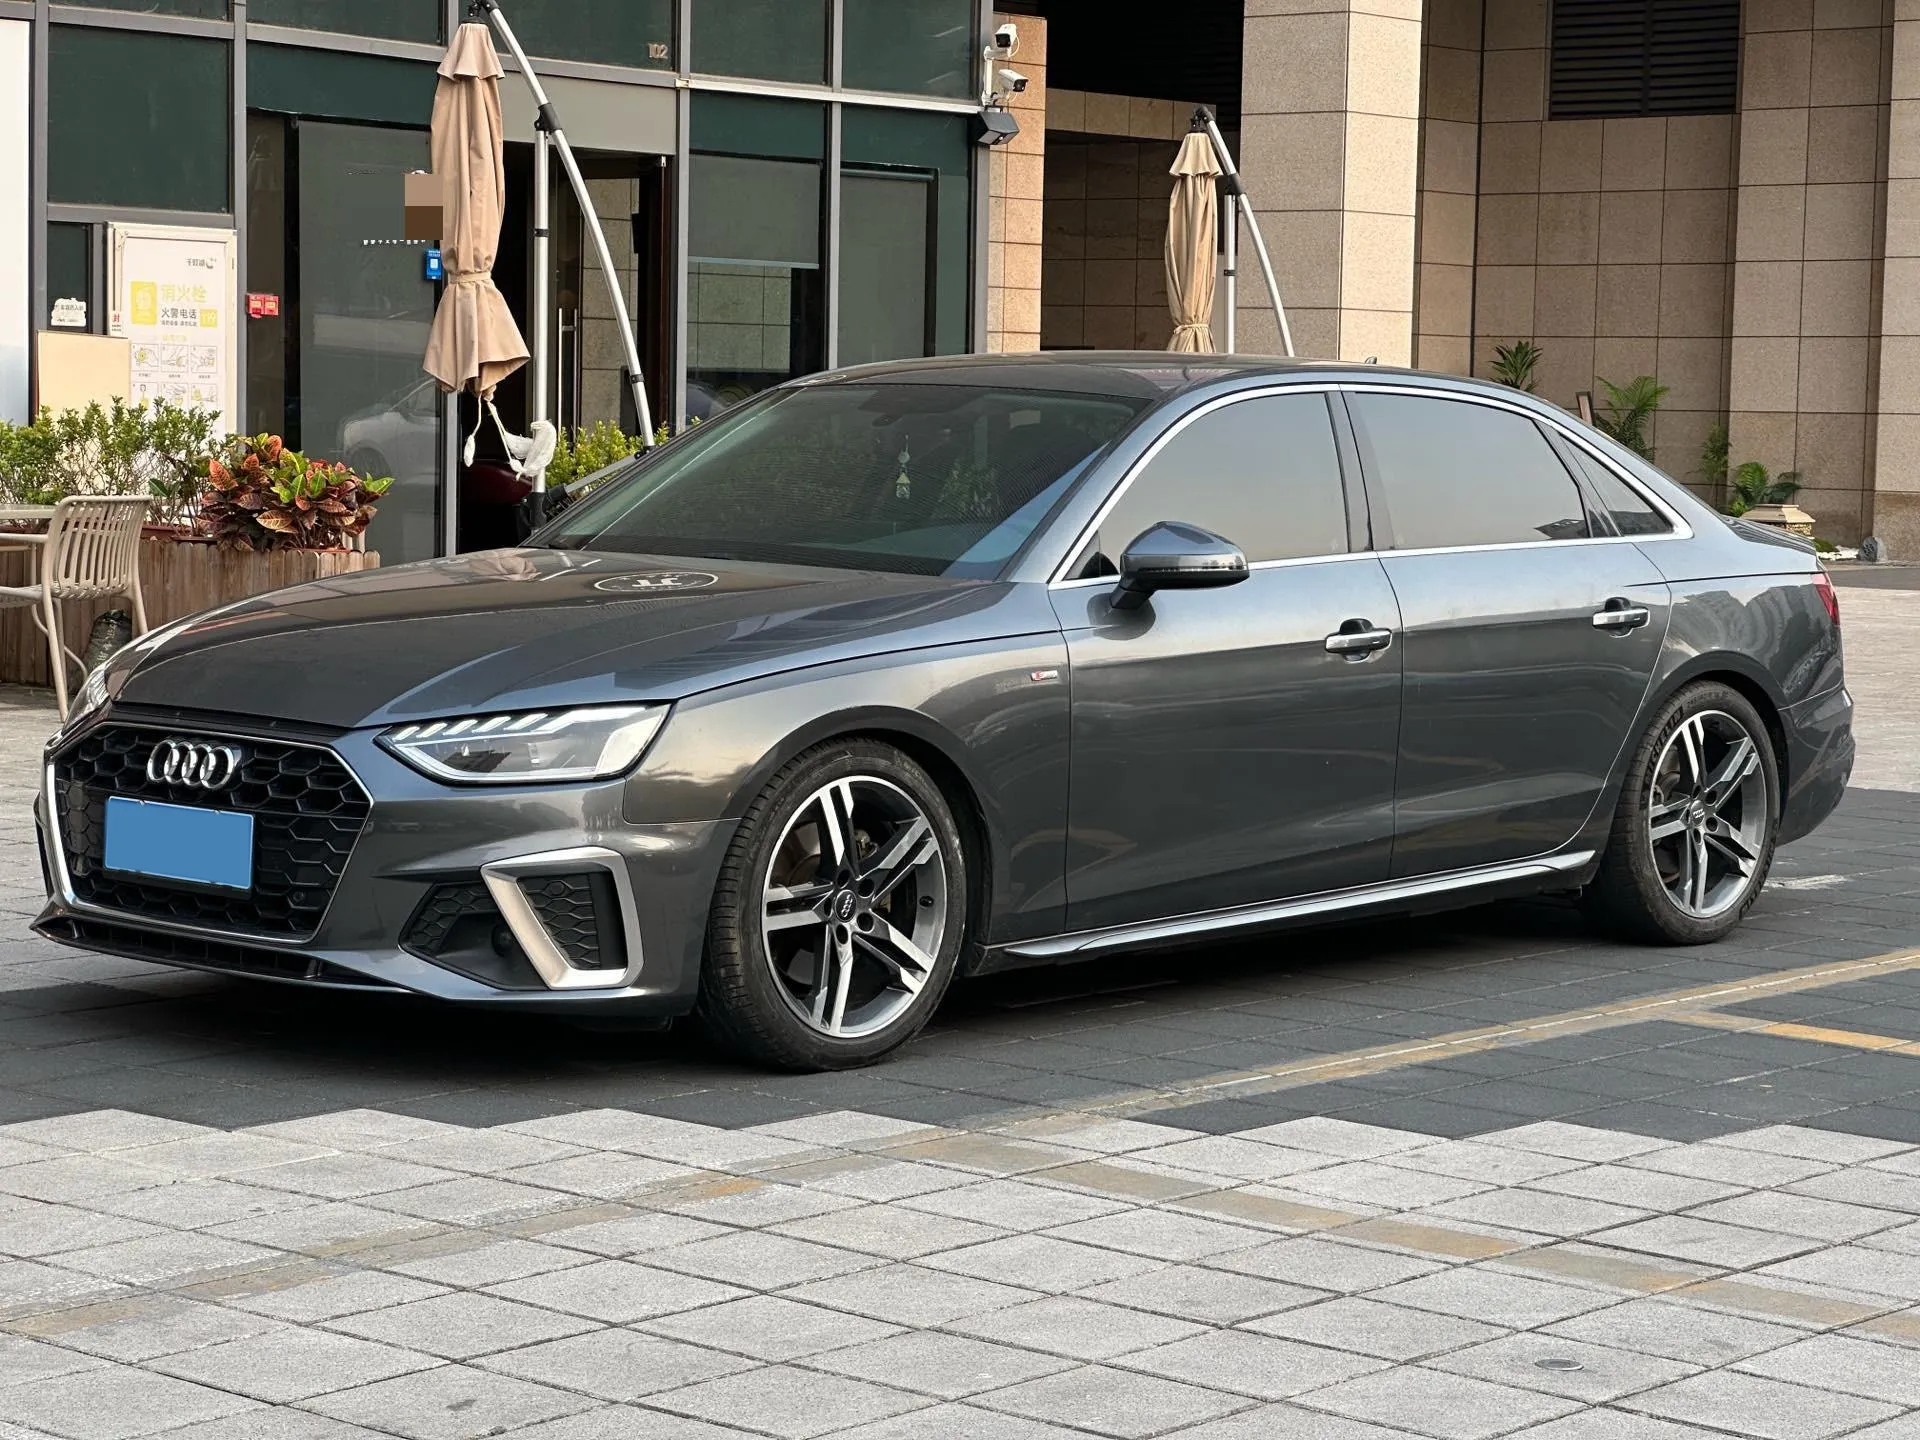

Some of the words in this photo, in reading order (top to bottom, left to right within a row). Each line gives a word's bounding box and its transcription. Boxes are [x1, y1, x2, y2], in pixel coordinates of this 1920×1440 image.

[647, 43, 668, 59] 102
[161, 307, 198, 320] 火警电话
